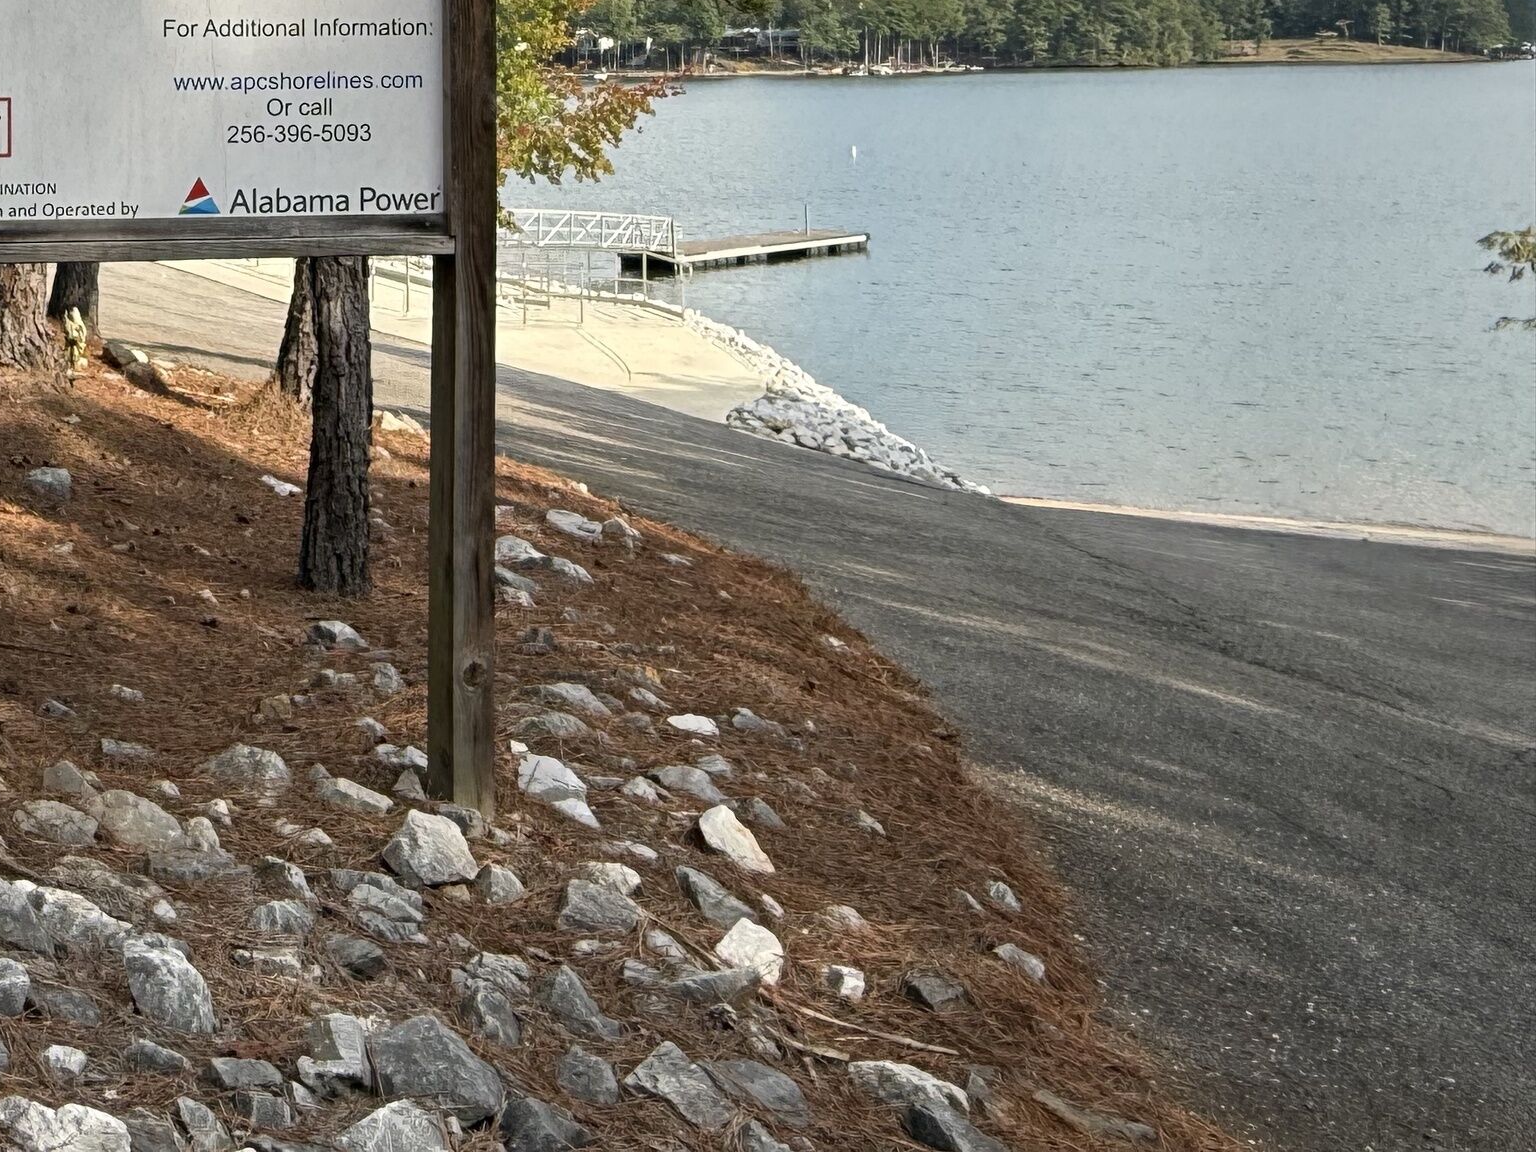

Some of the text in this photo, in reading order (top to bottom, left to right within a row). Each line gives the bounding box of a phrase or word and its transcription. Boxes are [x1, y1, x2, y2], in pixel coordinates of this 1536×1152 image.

[164, 18, 432, 37] For Additional Information:
[174, 72, 422, 94] www.apcshorelines.com
[267, 98, 331, 116] Or call
[228, 124, 371, 143] 256-396-5093
[230, 187, 441, 214] Alabama Power
[8, 201, 38, 220] and
[42, 200, 117, 222] Operated
[120, 200, 140, 220] by
